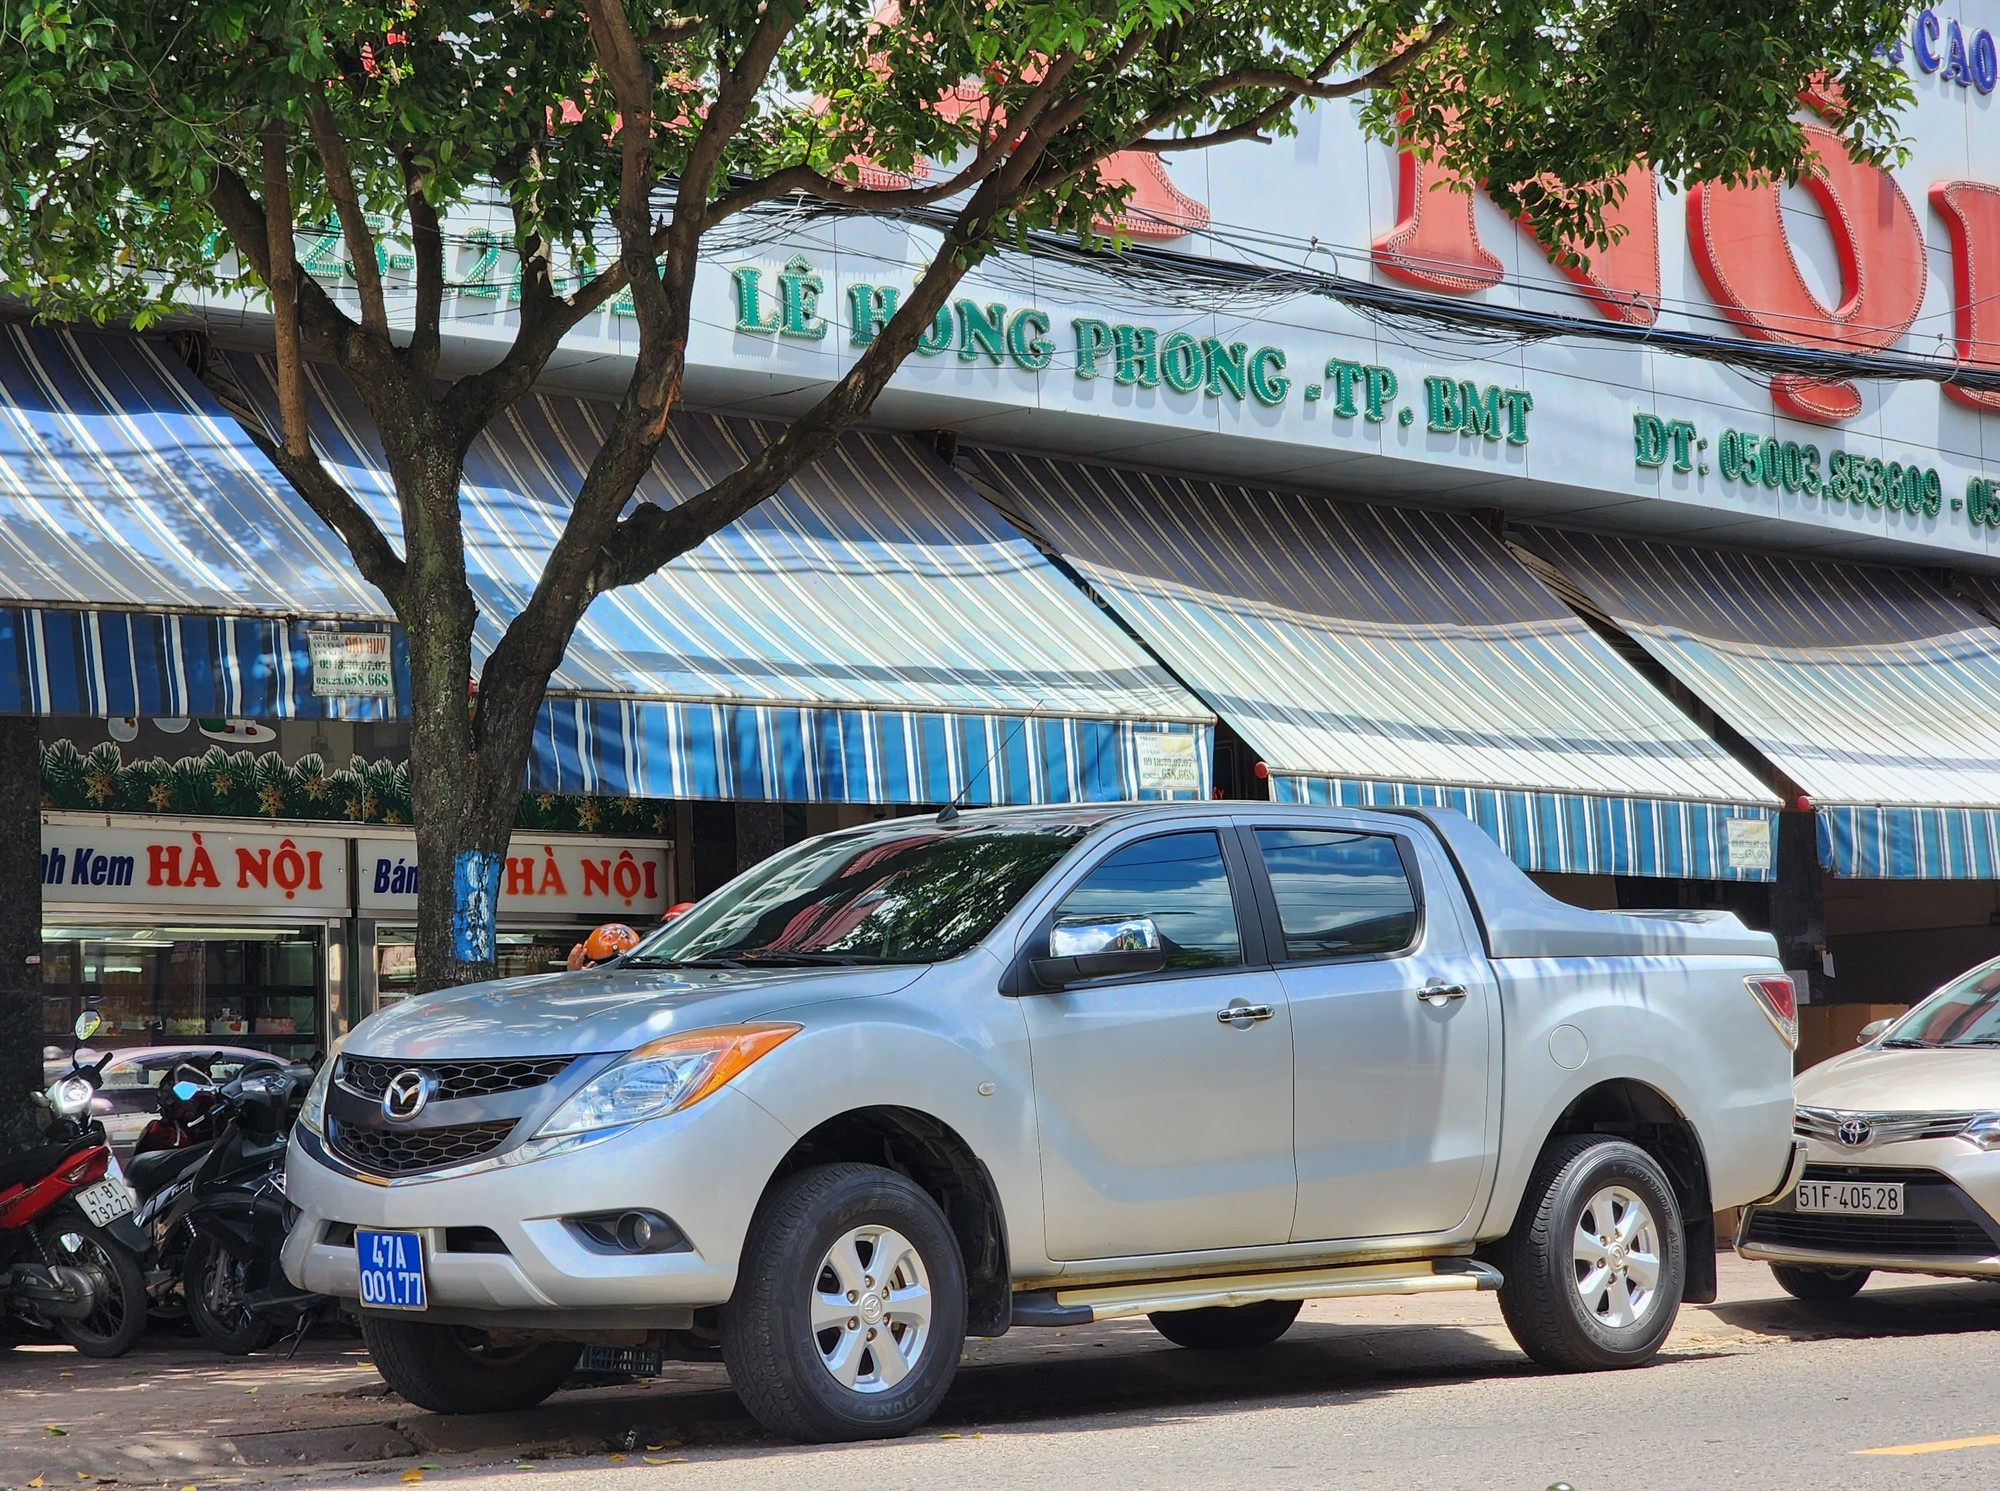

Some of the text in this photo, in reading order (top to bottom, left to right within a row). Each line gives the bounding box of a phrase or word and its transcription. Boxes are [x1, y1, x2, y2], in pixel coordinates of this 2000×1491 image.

[1912, 10, 1998, 95] CAO
[733, 254, 828, 340] LÊ
[1071, 317, 1292, 407] PHONG
[1424, 375, 1535, 446] BMT
[1633, 412, 1710, 477] ĐT:
[1718, 426, 1943, 519] 05003.853609
[365, 637, 386, 655] HUY
[317, 672, 389, 686] 02623.658.668
[71, 847, 135, 886] Kem
[147, 832, 221, 888] HÀ
[235, 838, 323, 900] NỘI
[505, 846, 568, 896] HÀ
[581, 850, 658, 907] NỘI
[85, 1182, 119, 1207] 47-B1
[91, 1195, 133, 1224] 792.27
[1799, 1185, 1898, 1210] 51F-405.28
[372, 1235, 407, 1269] 47A
[361, 1269, 421, 1305] 001.77
